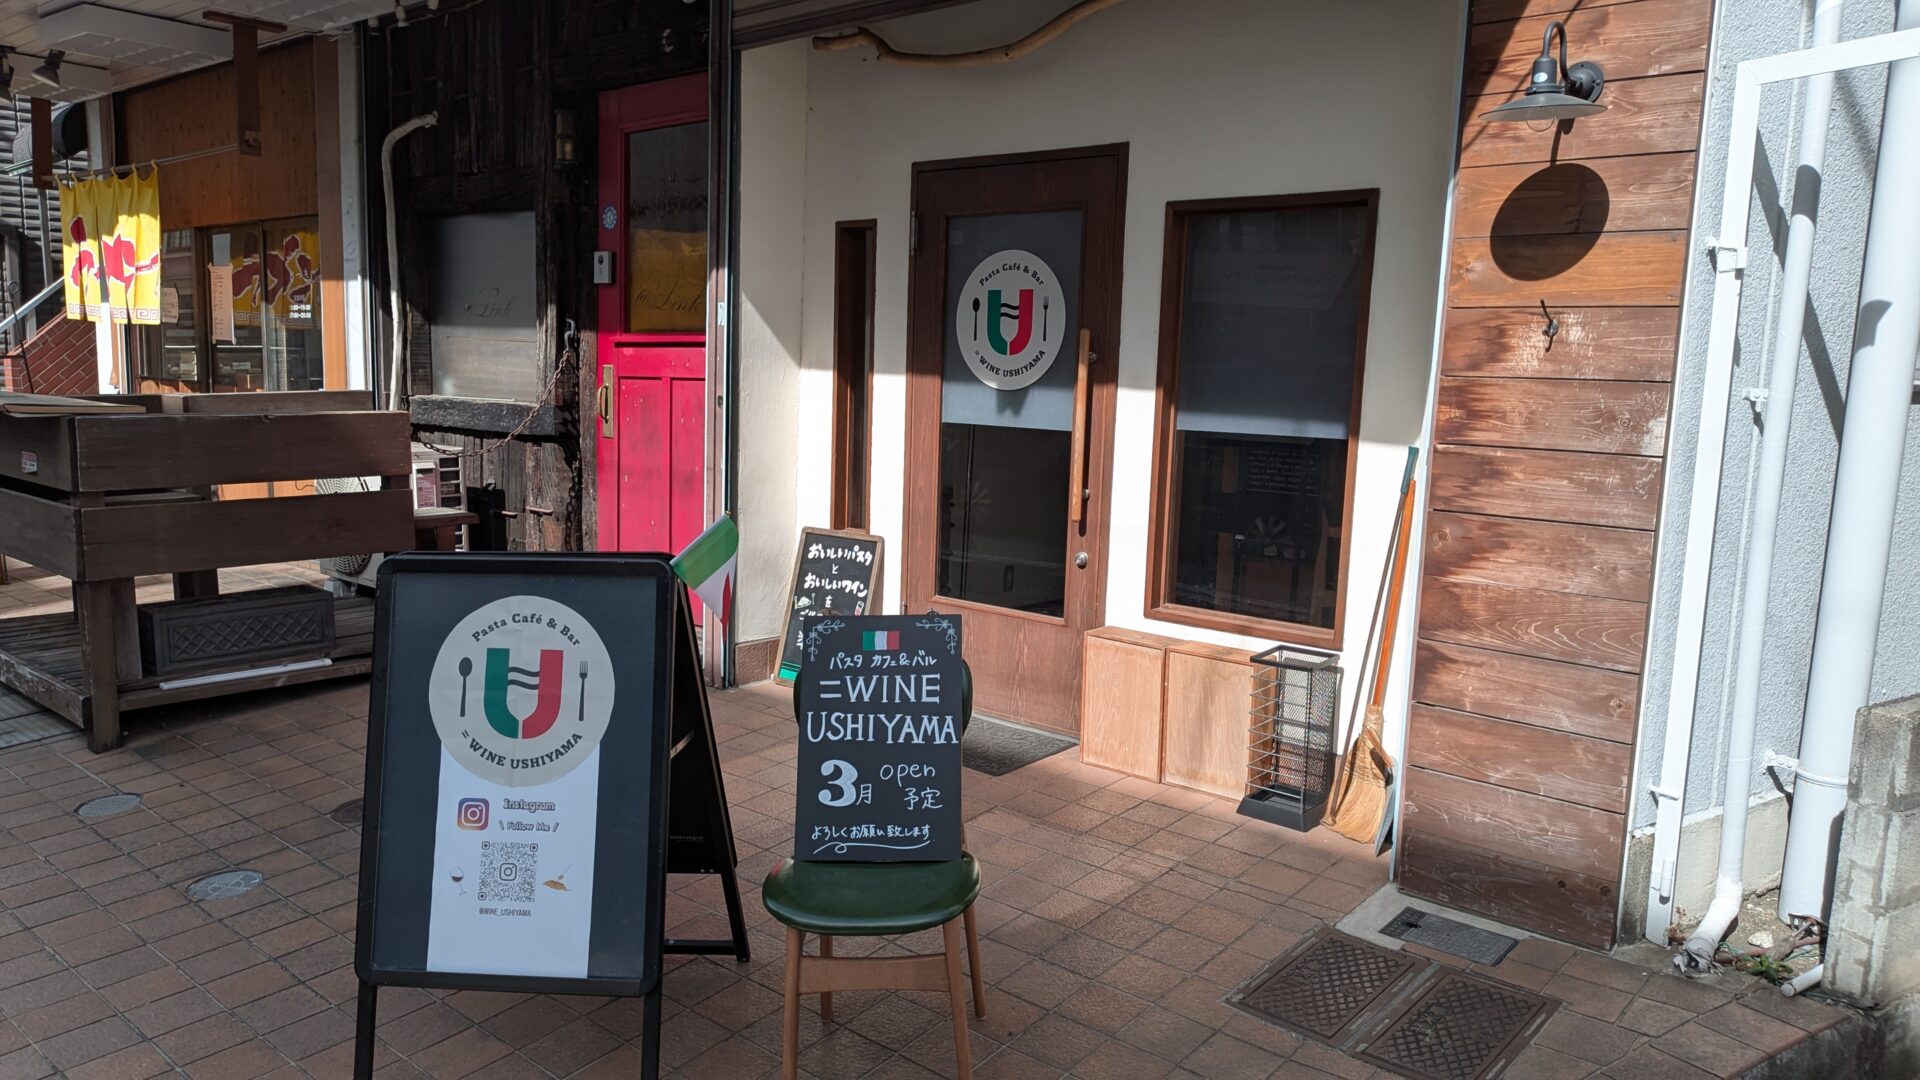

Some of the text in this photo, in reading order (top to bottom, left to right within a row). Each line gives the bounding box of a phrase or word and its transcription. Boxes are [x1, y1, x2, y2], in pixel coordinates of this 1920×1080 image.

[979, 263, 1044, 287] Pasta Café & Bar
[979, 355, 1001, 376] WINE
[1002, 350, 1046, 378] USHIYAMA
[807, 543, 874, 566] おいしいパスタ
[832, 563, 840, 574] と
[803, 572, 868, 597] おいしいワイン
[824, 595, 833, 608] を
[472, 613, 581, 646] Pasta Café & Bar
[829, 651, 863, 670] パスタ
[806, 711, 959, 745] USHIYAMA
[469, 737, 507, 767] WINE
[510, 732, 583, 769] USHIYAMA
[879, 763, 936, 788] open
[503, 798, 556, 813] Instagram
[903, 786, 943, 811] 予定
[506, 820, 551, 832] Follow Me
[811, 824, 931, 840] よろしくお願い致します
[478, 907, 532, 917] @WINE_USHIYAMA
